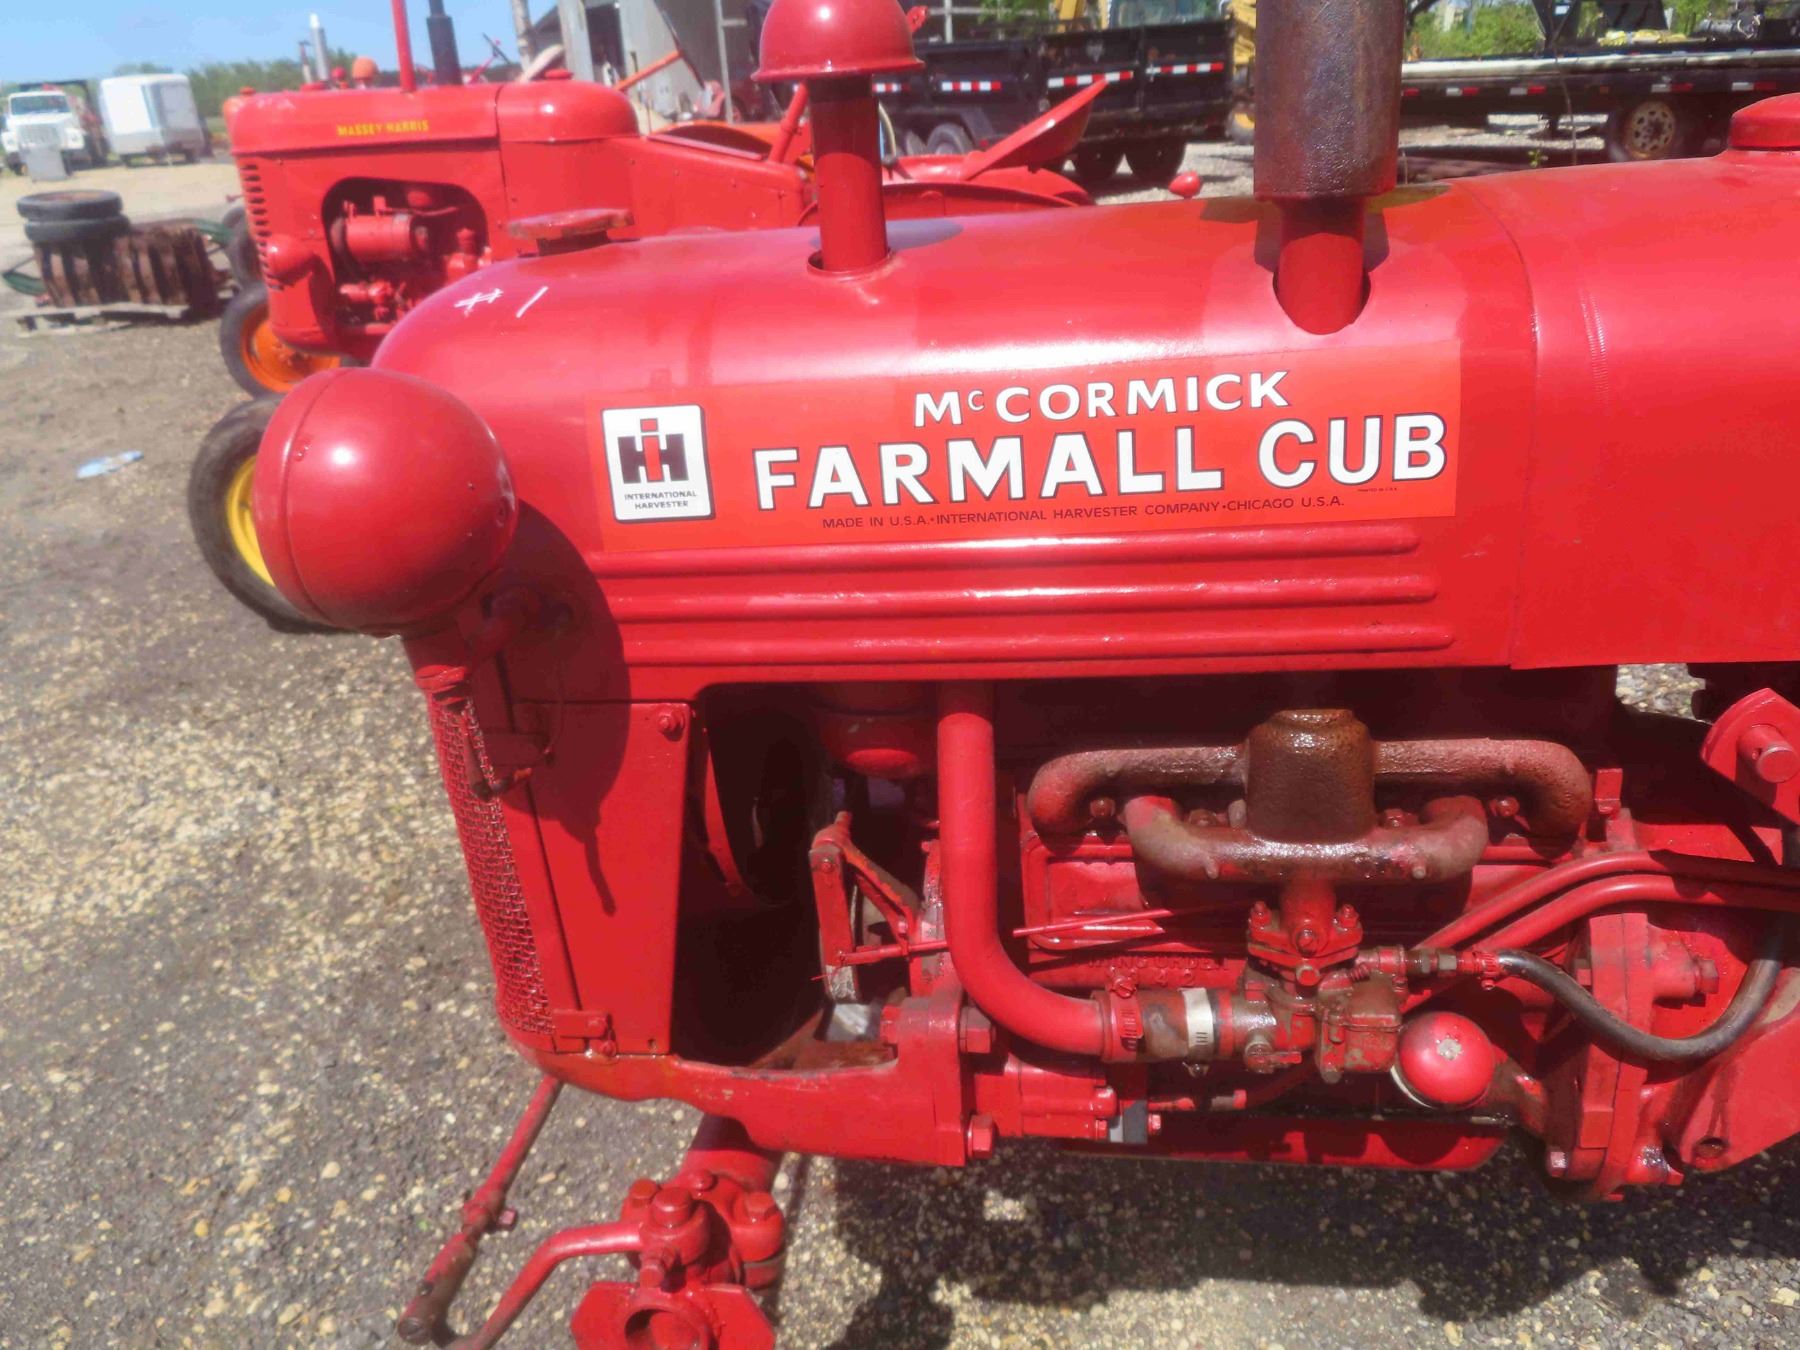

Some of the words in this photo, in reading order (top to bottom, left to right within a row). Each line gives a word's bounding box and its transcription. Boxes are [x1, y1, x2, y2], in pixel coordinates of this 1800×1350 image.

[752, 424, 1225, 511] FARMALL
[1257, 412, 1448, 489] CUB
[624, 490, 698, 501] INTERNATIONAL
[634, 500, 689, 510] HARVESTER
[822, 517, 863, 529] MADE
[869, 516, 884, 527] IN
[936, 510, 1047, 525] INTERNATIONAL
[1053, 505, 1138, 520] HARVESTER
[1144, 502, 1218, 516] COMPANY
[1227, 497, 1295, 511] CHICAGO
